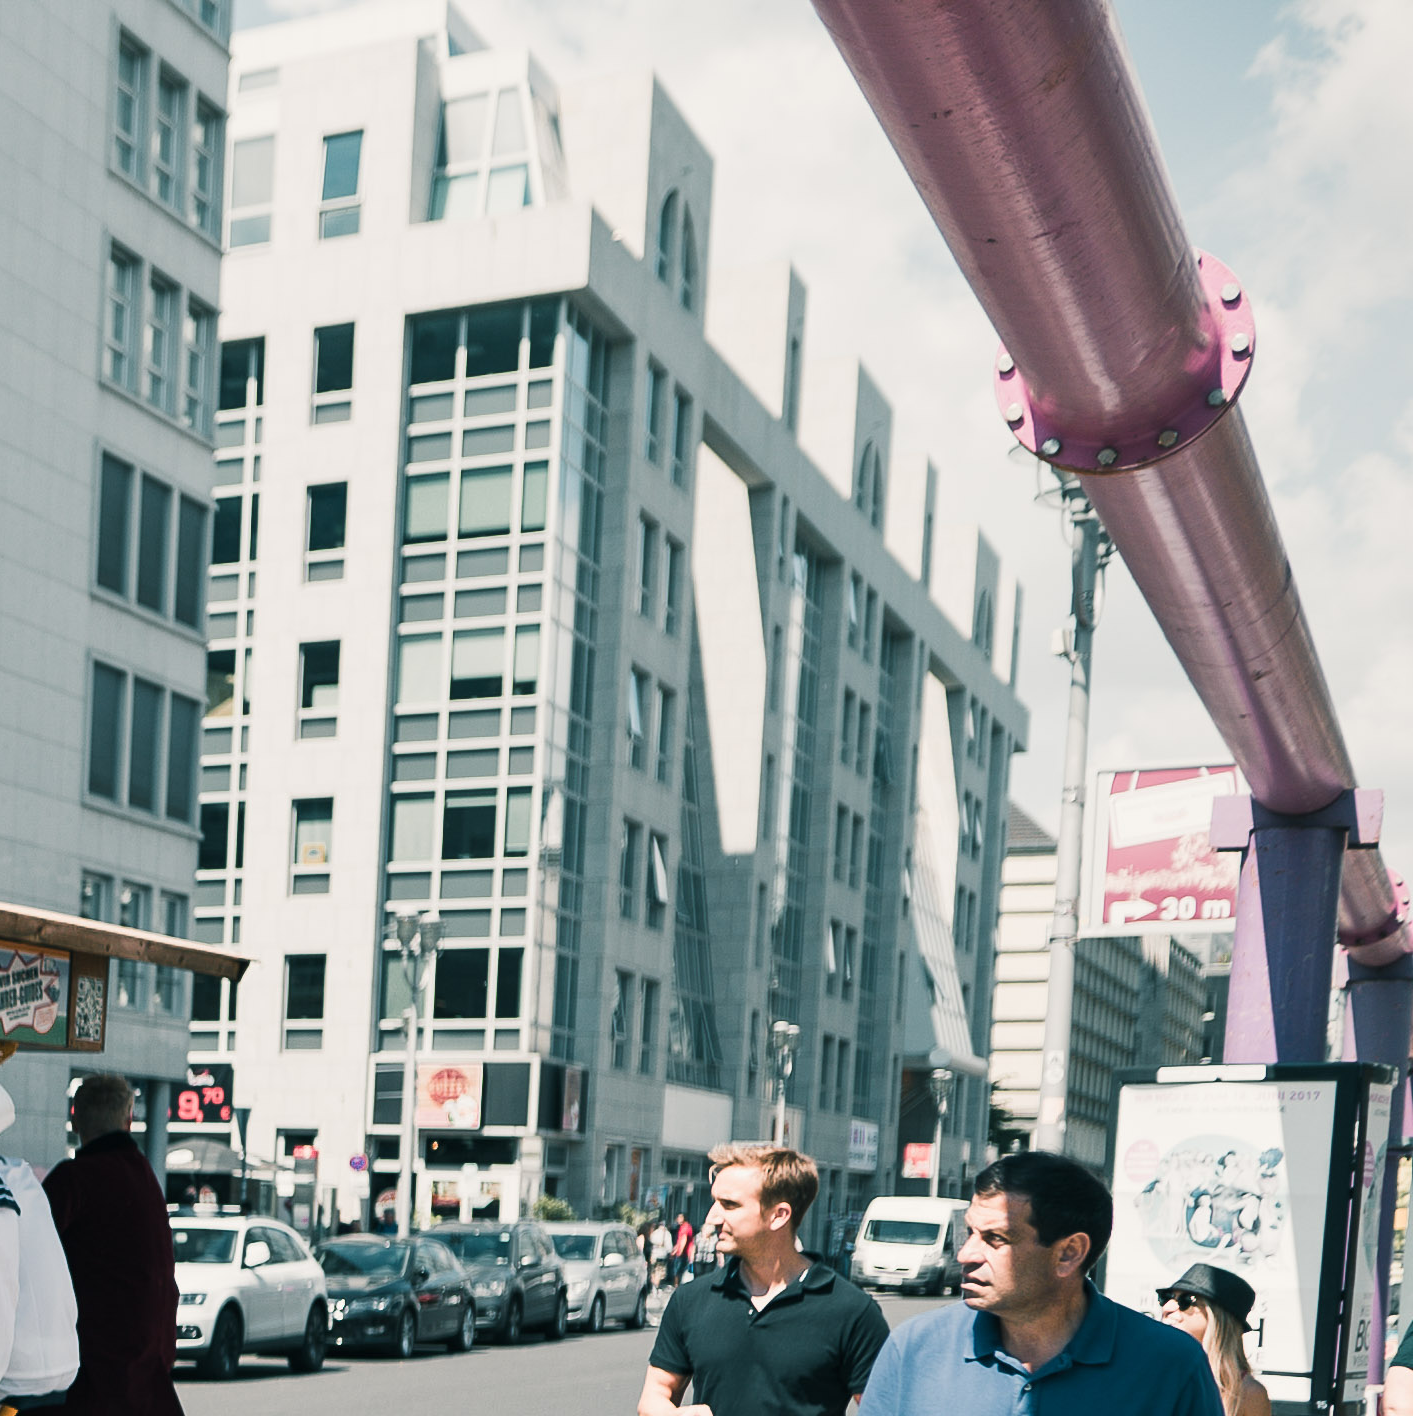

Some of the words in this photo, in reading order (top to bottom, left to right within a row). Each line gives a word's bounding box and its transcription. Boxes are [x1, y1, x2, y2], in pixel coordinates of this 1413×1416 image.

[1159, 896, 1196, 919] 30
[1200, 898, 1231, 918] m
[1289, 1090, 1321, 1101] 2017
